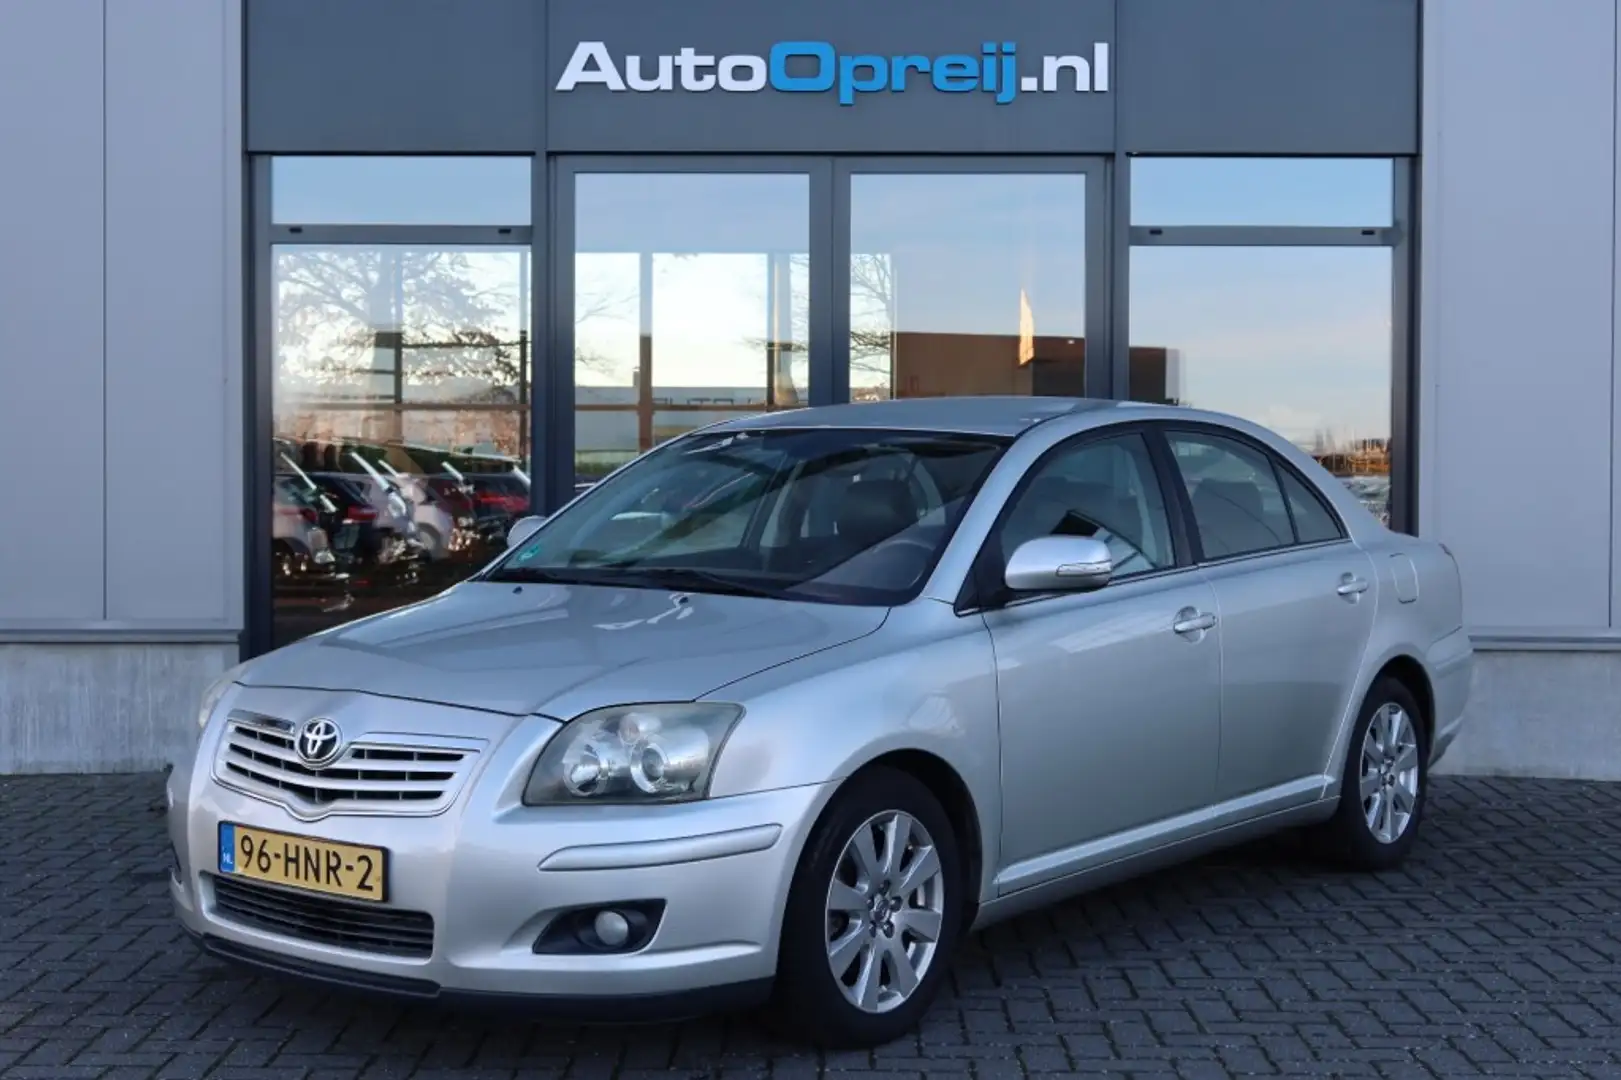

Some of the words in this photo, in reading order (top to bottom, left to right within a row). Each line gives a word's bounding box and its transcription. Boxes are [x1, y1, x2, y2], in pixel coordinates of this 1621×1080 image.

[555, 41, 1109, 105] AutoOpreij.nl
[222, 852, 233, 865] NL
[240, 834, 374, 892] 96-HNR-2
